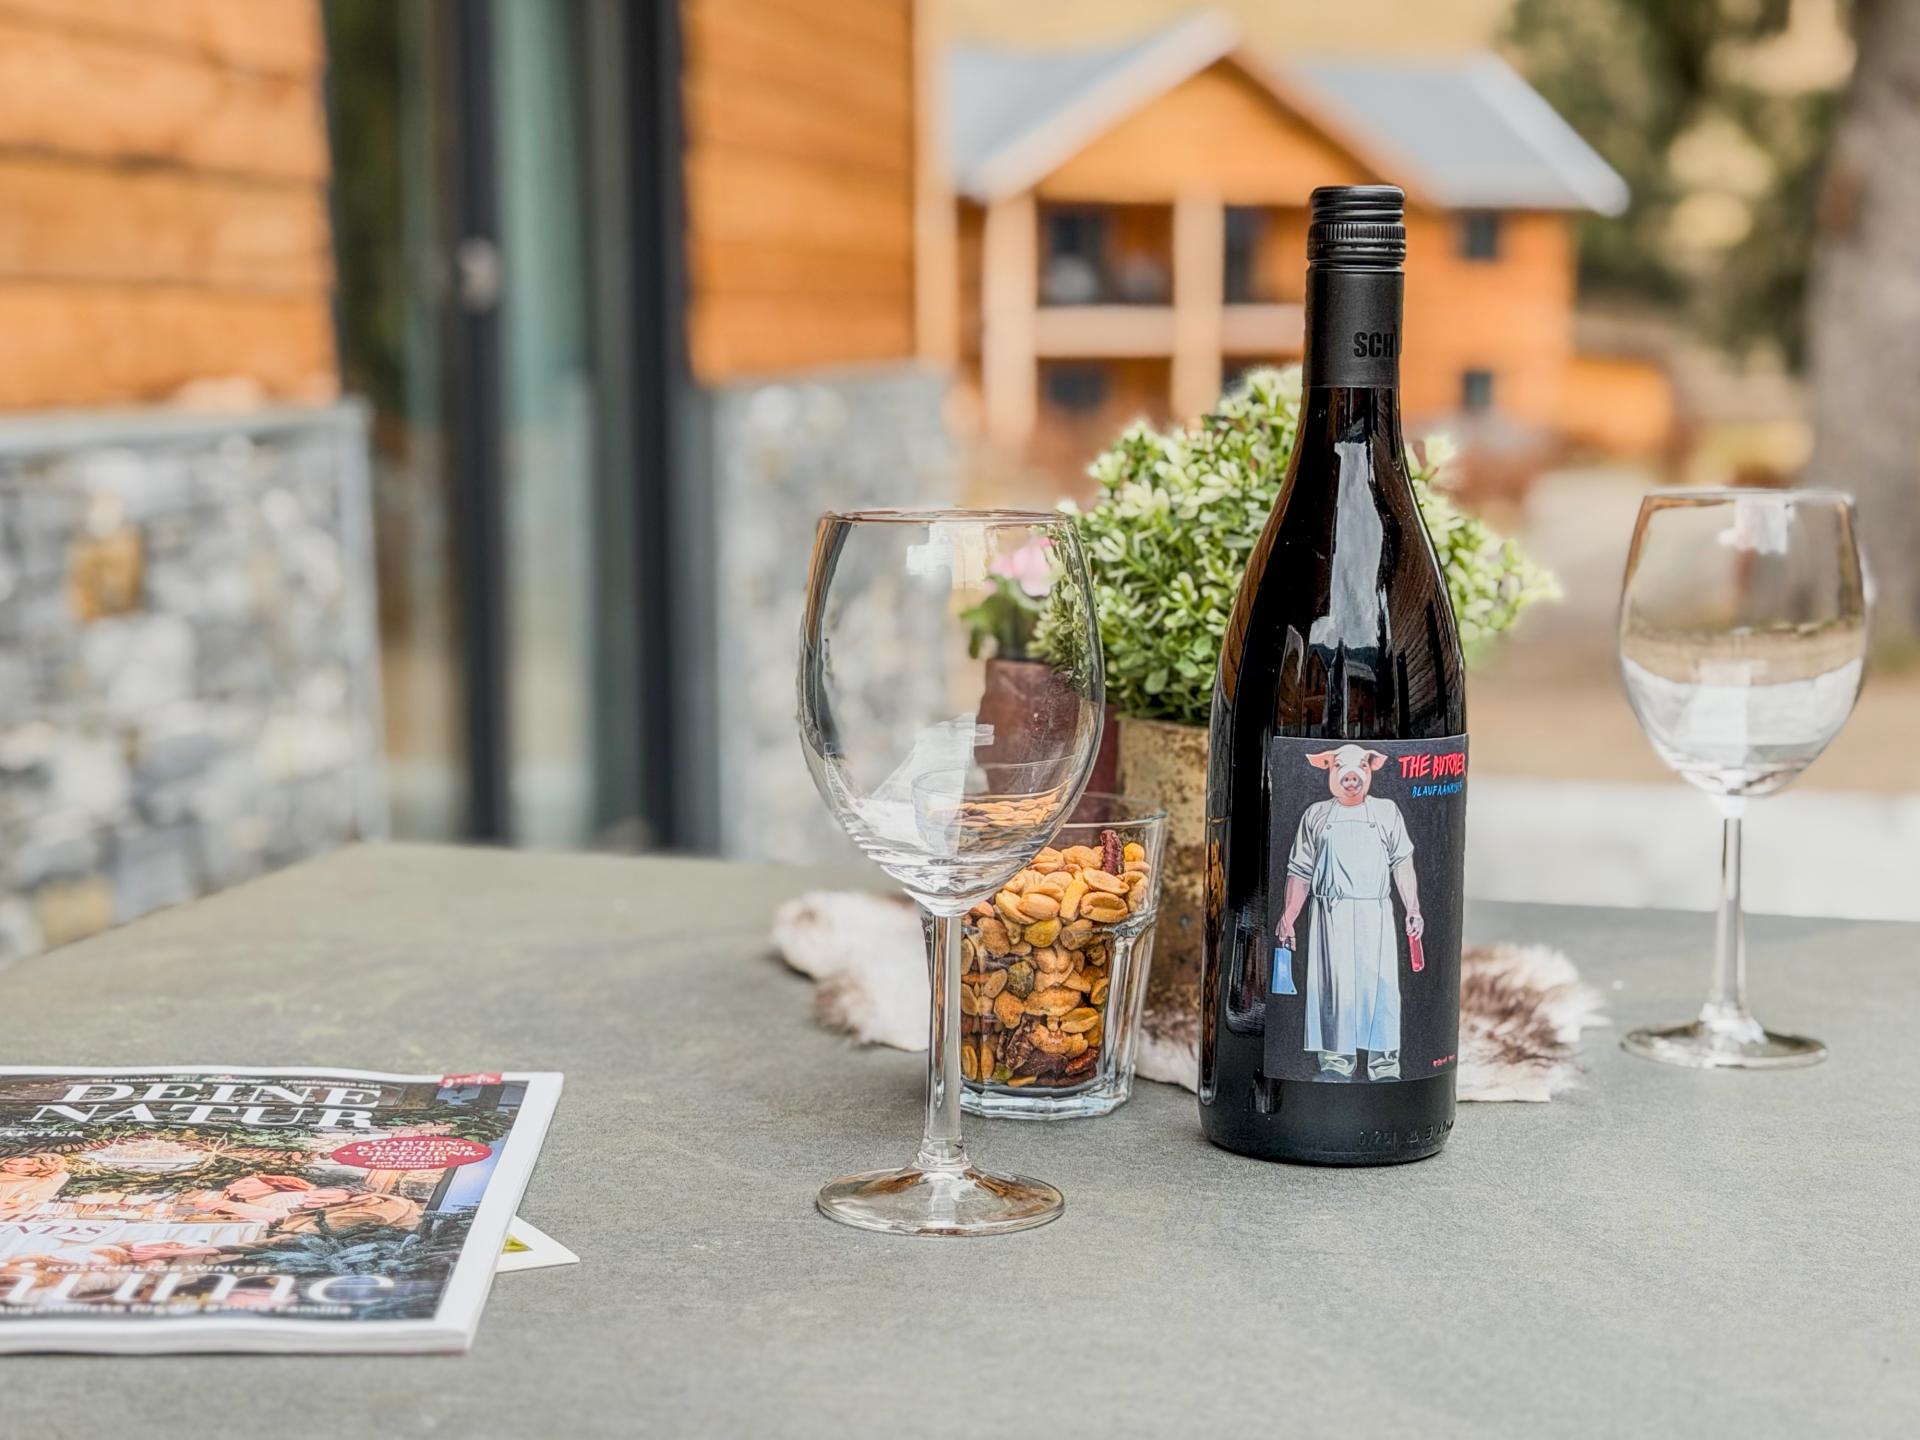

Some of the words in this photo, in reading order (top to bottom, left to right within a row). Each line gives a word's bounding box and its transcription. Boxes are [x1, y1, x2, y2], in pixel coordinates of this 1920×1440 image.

[1398, 753, 1431, 778] THE
[51, 1084, 382, 1108] DEINE
[21, 1104, 377, 1128] NATUR
[46, 1264, 182, 1272] KUSCHELIGE
[187, 1264, 278, 1273] WINTER-
